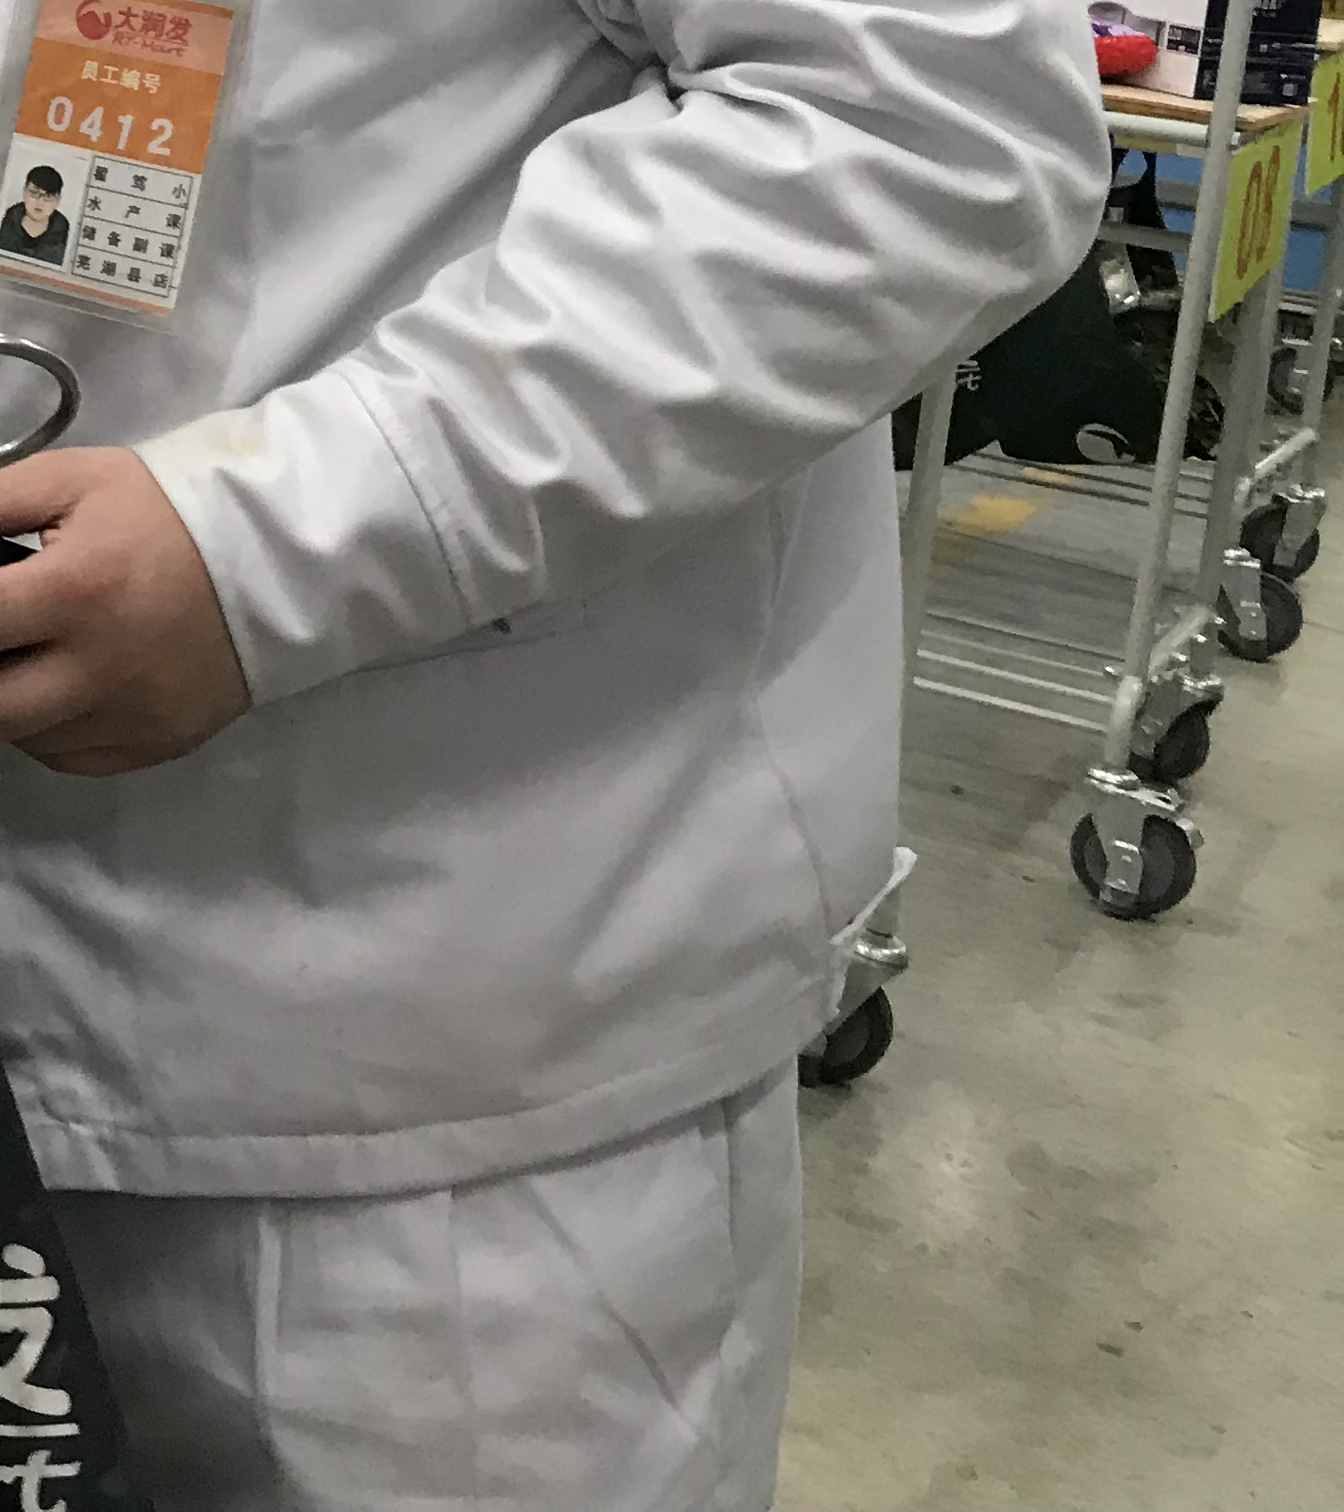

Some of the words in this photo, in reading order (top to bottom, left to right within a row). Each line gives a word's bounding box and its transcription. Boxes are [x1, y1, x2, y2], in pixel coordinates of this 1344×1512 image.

[114, 6, 193, 41] 大润发
[111, 29, 186, 58] RT-Mart
[80, 59, 161, 94] 员工编号
[46, 95, 175, 157] 0412
